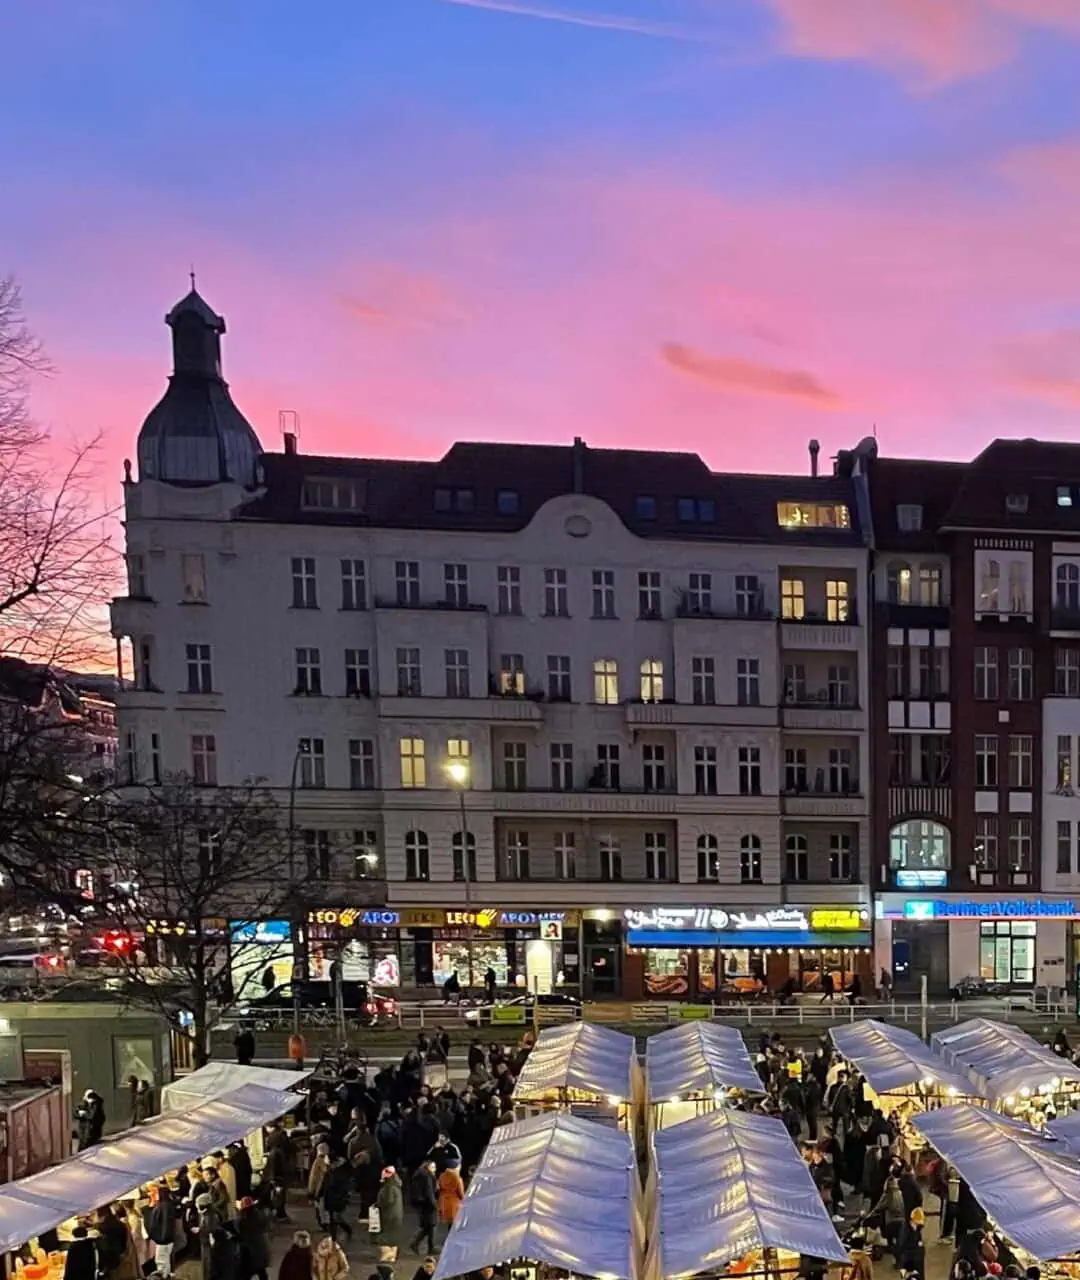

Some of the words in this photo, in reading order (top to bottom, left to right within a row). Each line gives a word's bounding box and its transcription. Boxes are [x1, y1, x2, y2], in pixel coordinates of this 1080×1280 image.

[936, 900, 998, 916] Berliner
[1000, 900, 1076, 916] Volksbank
[446, 911, 475, 925] LEO
